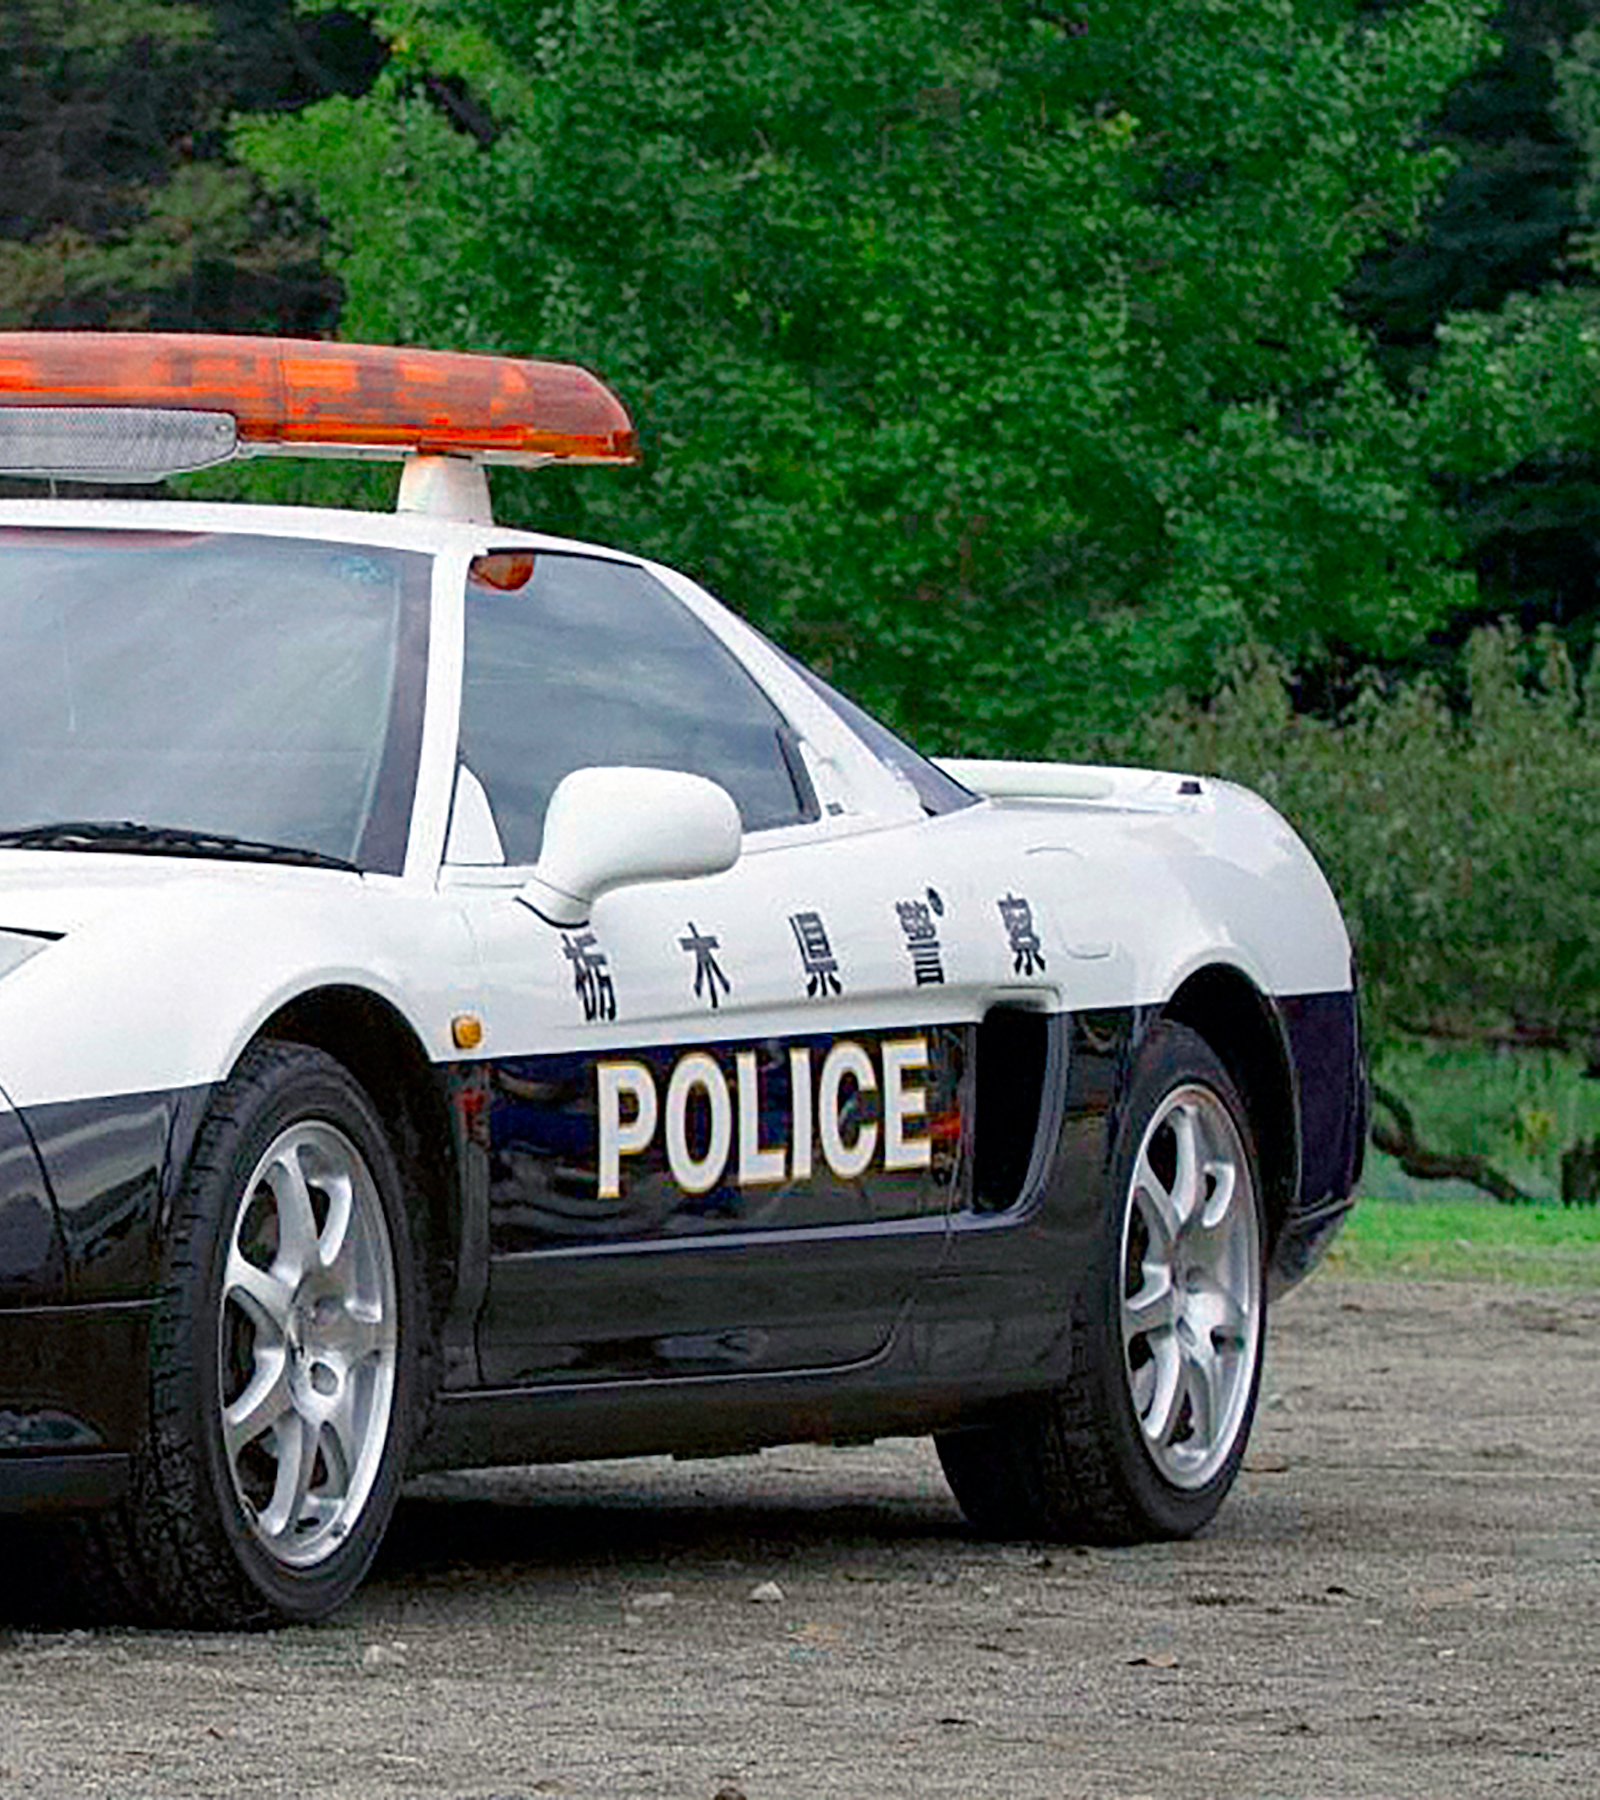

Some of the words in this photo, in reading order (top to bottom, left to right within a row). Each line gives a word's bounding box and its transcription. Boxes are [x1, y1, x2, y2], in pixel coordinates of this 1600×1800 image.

[561, 886, 1046, 1021] 栃木県警察
[596, 1038, 934, 1199] POLICE
